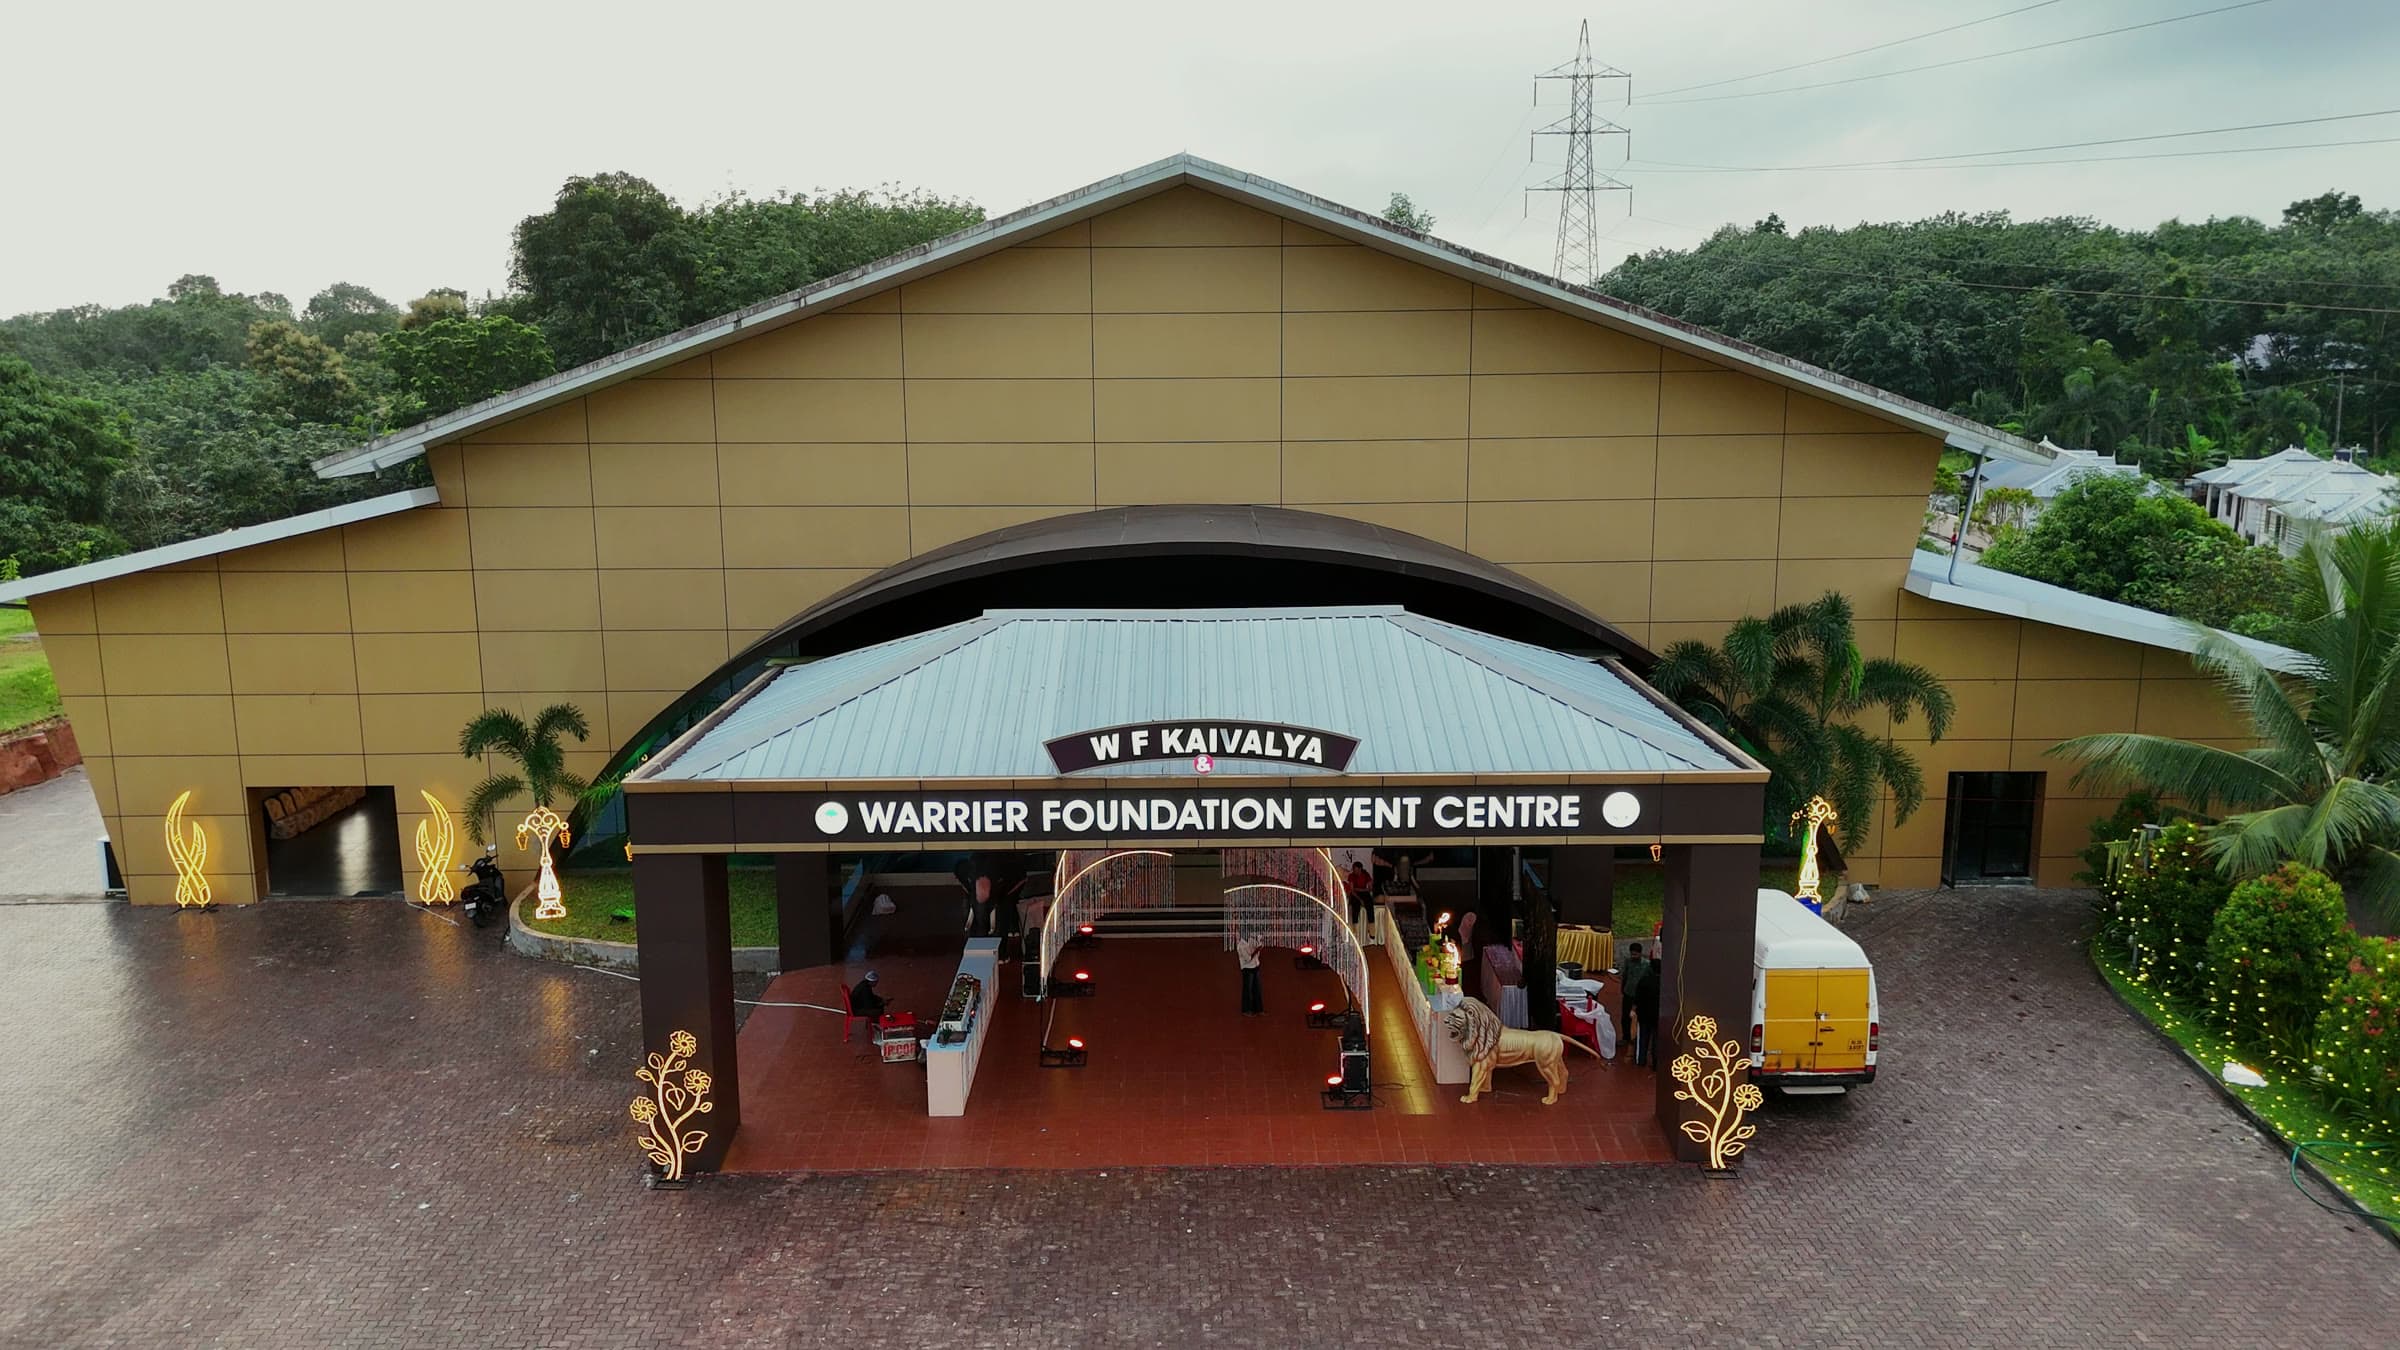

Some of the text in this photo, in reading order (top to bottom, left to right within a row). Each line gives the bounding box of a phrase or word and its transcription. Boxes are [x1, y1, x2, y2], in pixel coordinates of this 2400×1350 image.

[1090, 728, 1323, 764] W F KAIVALYA
[1196, 756, 1211, 772] &
[858, 795, 1580, 834] WARRIER FOUNDATION EVENT CENTRE
